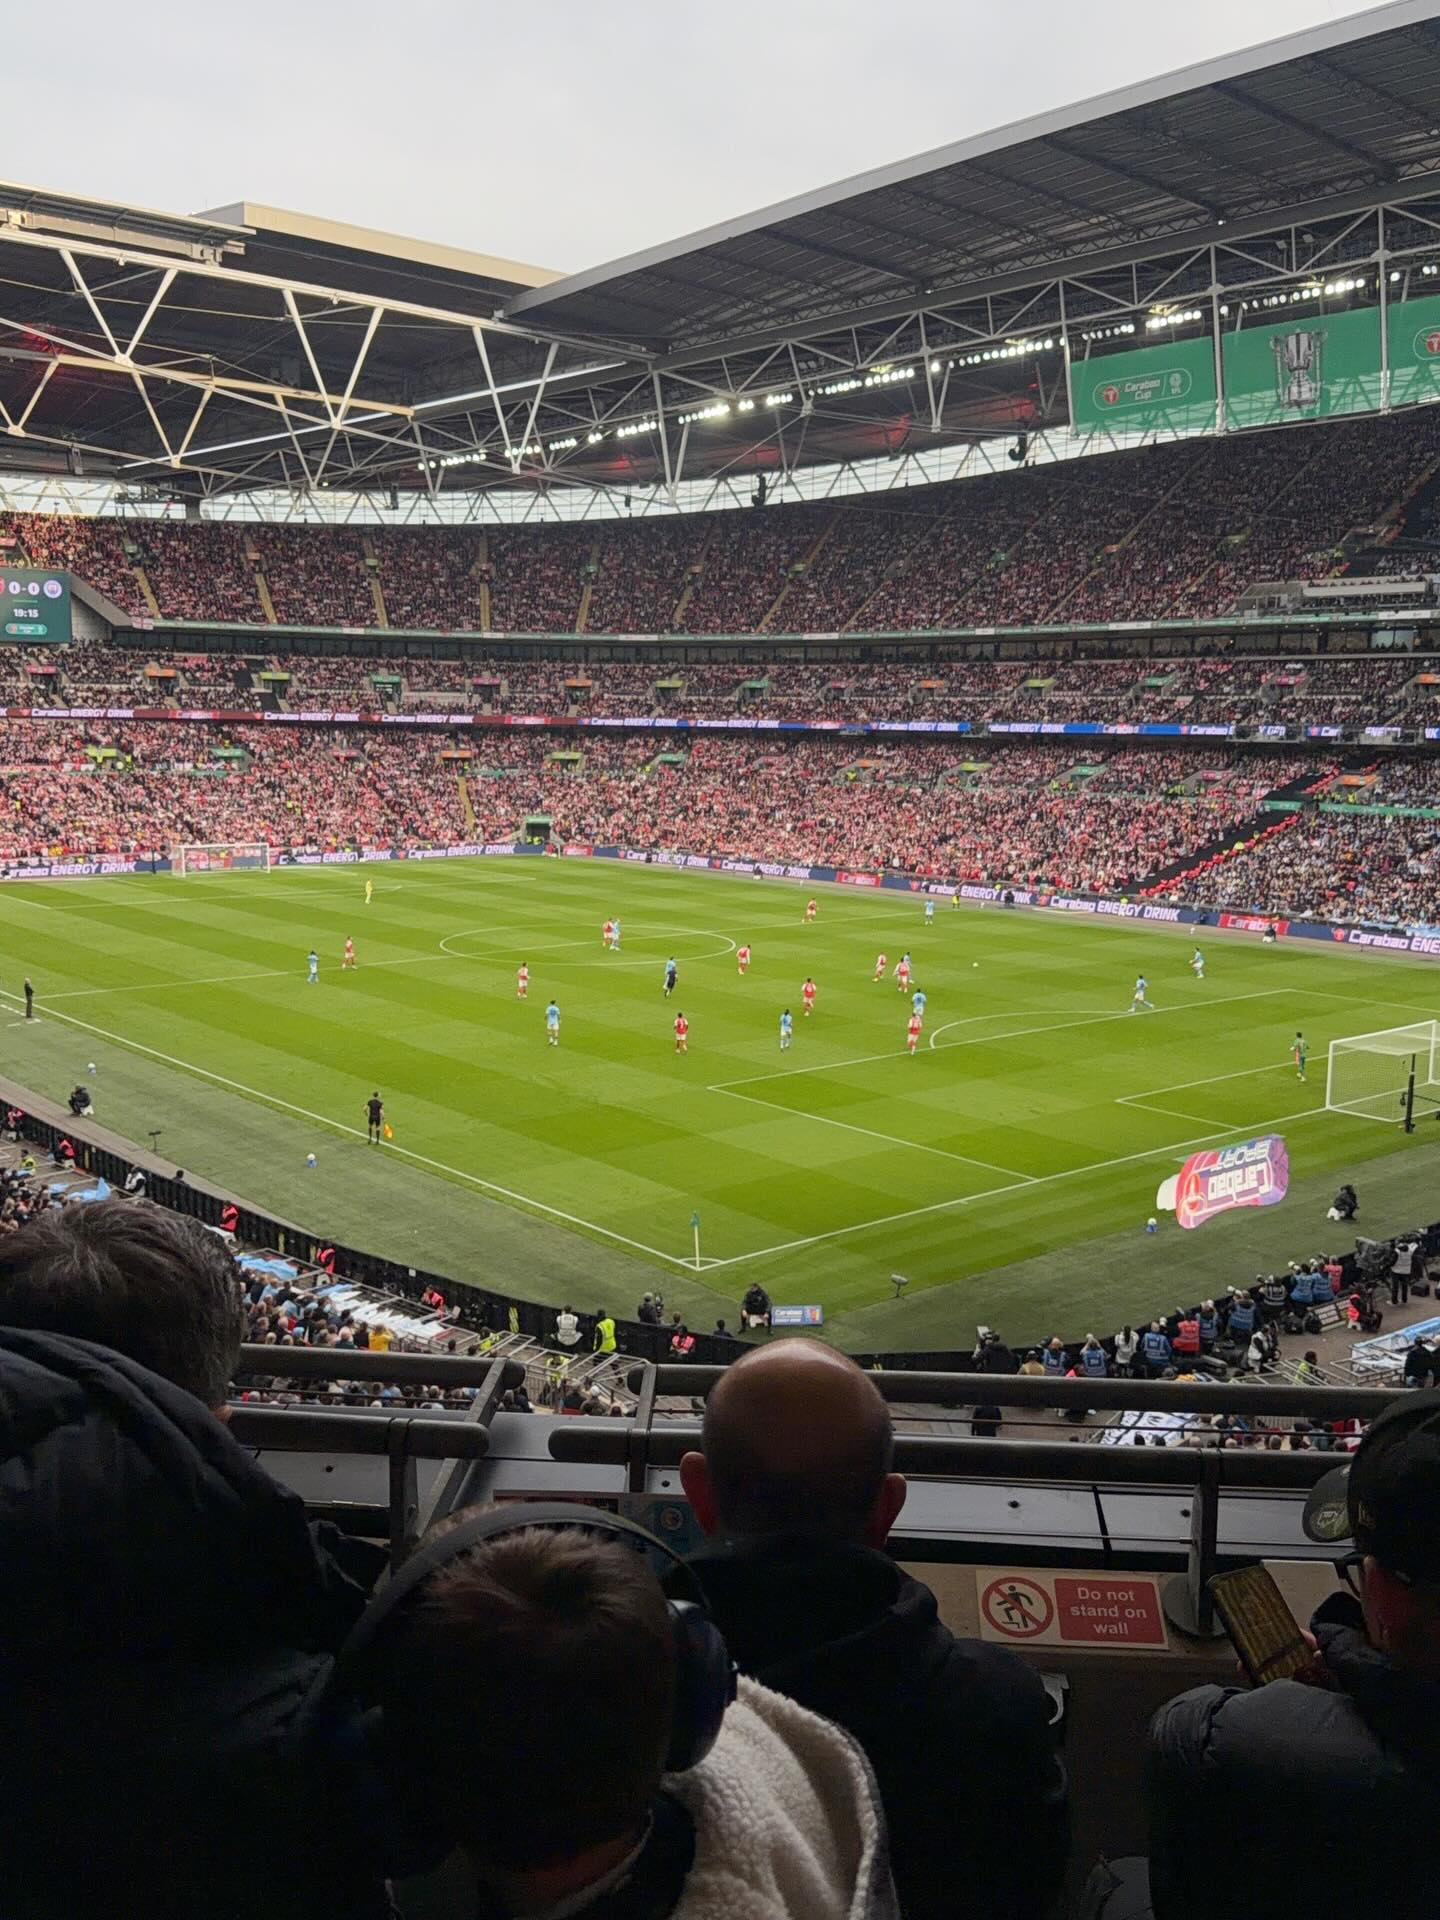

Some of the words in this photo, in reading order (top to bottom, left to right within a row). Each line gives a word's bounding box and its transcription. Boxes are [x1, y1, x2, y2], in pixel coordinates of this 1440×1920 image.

[1124, 380, 1160, 392] Carabao
[1134, 390, 1152, 400] Cup
[13, 608, 39, 618] 19:15
[31, 708, 70, 717] Carabao
[70, 708, 106, 718] ENERGY
[107, 708, 135, 718] DRINK
[408, 849, 446, 858] Carabao
[448, 846, 484, 857] ENERGY
[485, 844, 516, 855] DRINK
[51, 863, 99, 876] ENERGY
[101, 861, 137, 874] DRINK
[721, 859, 753, 873] Carabao
[960, 885, 998, 900] ENERGY
[1050, 895, 1096, 913] Carabao
[1097, 900, 1141, 917] ENERGY
[1144, 906, 1181, 922] DRINK
[1348, 929, 1409, 949] Carabao
[1208, 1162, 1271, 1200] Carabao
[1077, 1587, 1101, 1600] Do
[1107, 1590, 1135, 1601] not
[1071, 1605, 1119, 1617] stand
[1125, 1607, 1147, 1619] on
[1093, 1622, 1129, 1635] wall
